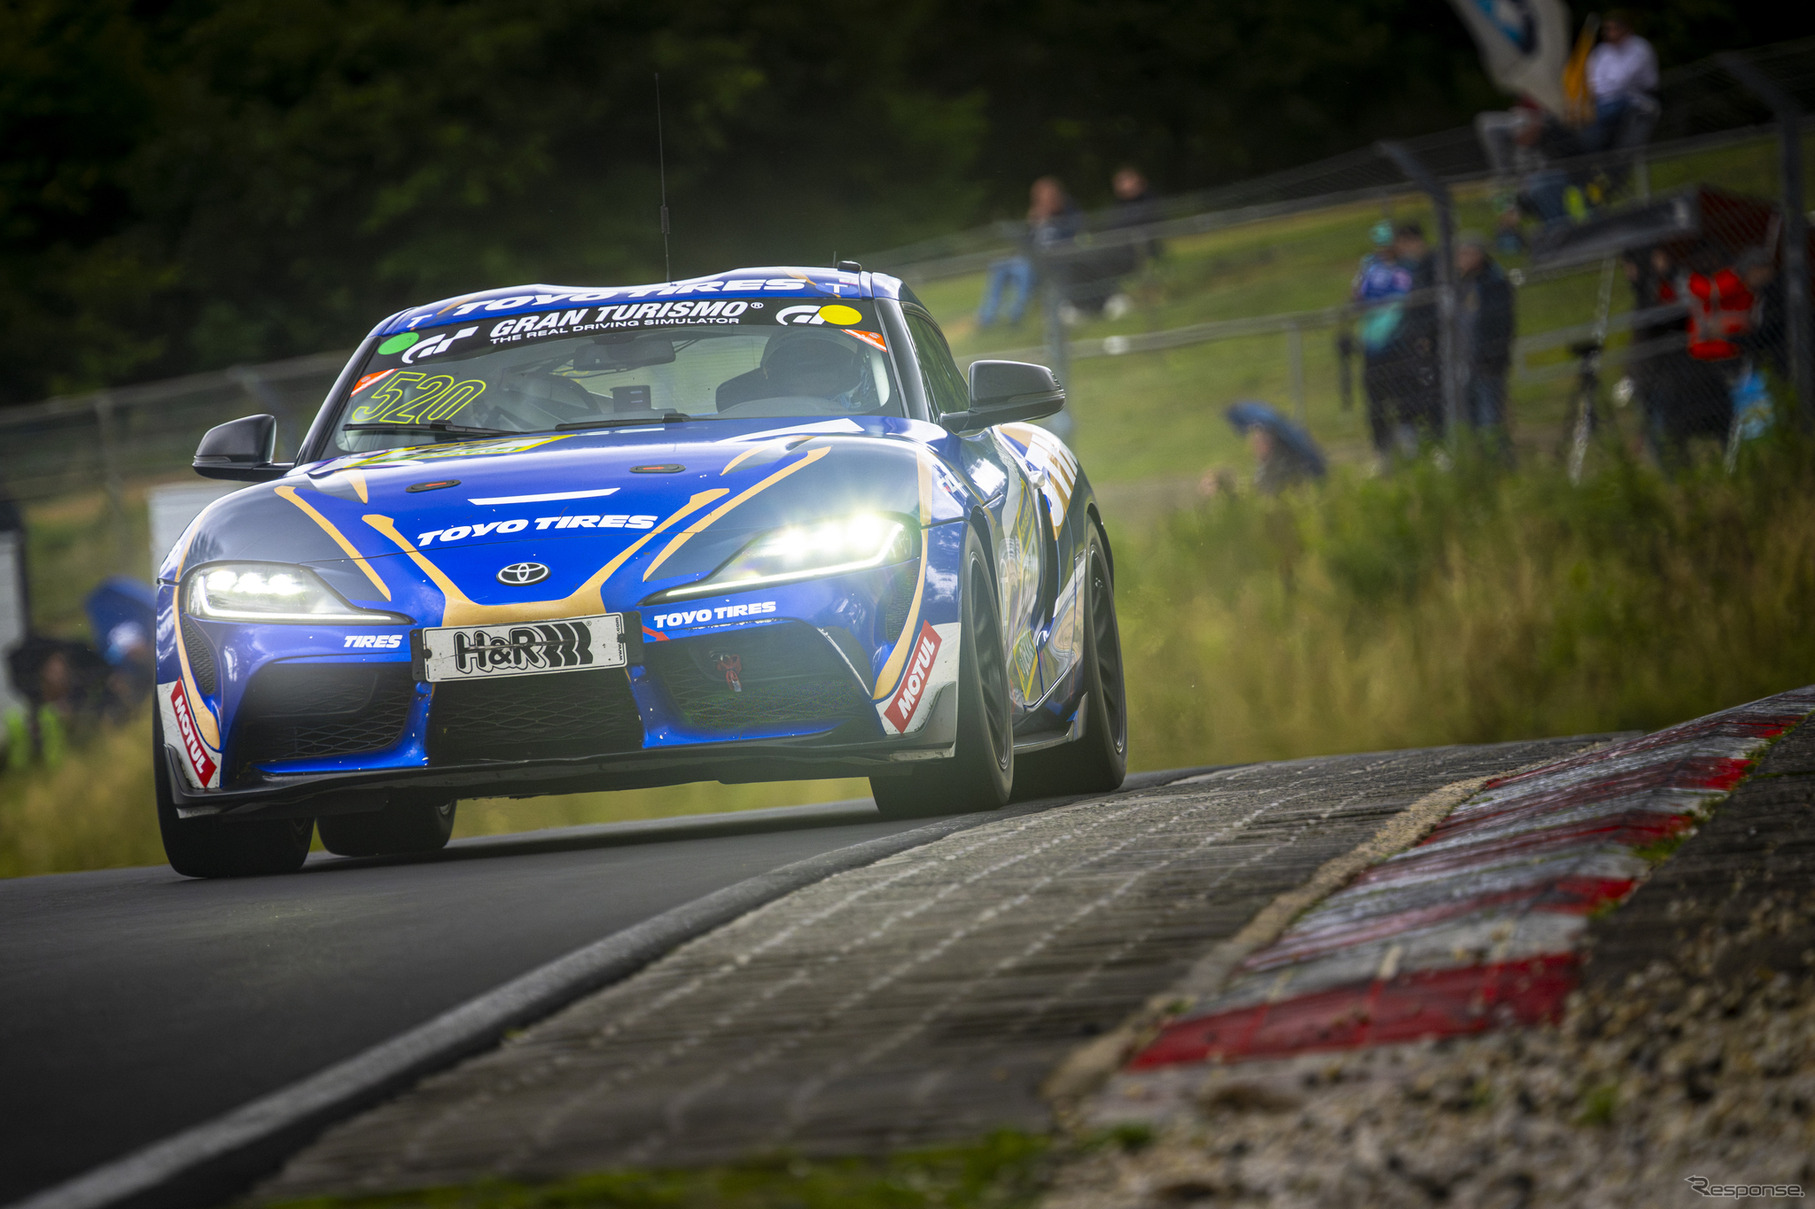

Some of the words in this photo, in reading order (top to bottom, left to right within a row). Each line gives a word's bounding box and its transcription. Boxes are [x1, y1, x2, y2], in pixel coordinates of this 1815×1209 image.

[453, 292, 619, 316] TOYO
[627, 279, 807, 298] TIRES
[489, 308, 589, 338] GRAN
[490, 334, 522, 344] THE
[526, 328, 569, 339] REAL
[572, 320, 640, 332] DRIVING
[643, 317, 740, 326] SIMULATOR
[352, 371, 486, 425] 520
[417, 519, 529, 547] TOYO
[534, 515, 658, 530] TIRES
[654, 609, 712, 628] TOYO
[714, 601, 776, 619] TIRES
[343, 634, 403, 649] TIRES
[454, 628, 546, 673] H&R
[897, 636, 936, 719] MOTUL
[174, 695, 207, 774] MOTUL
